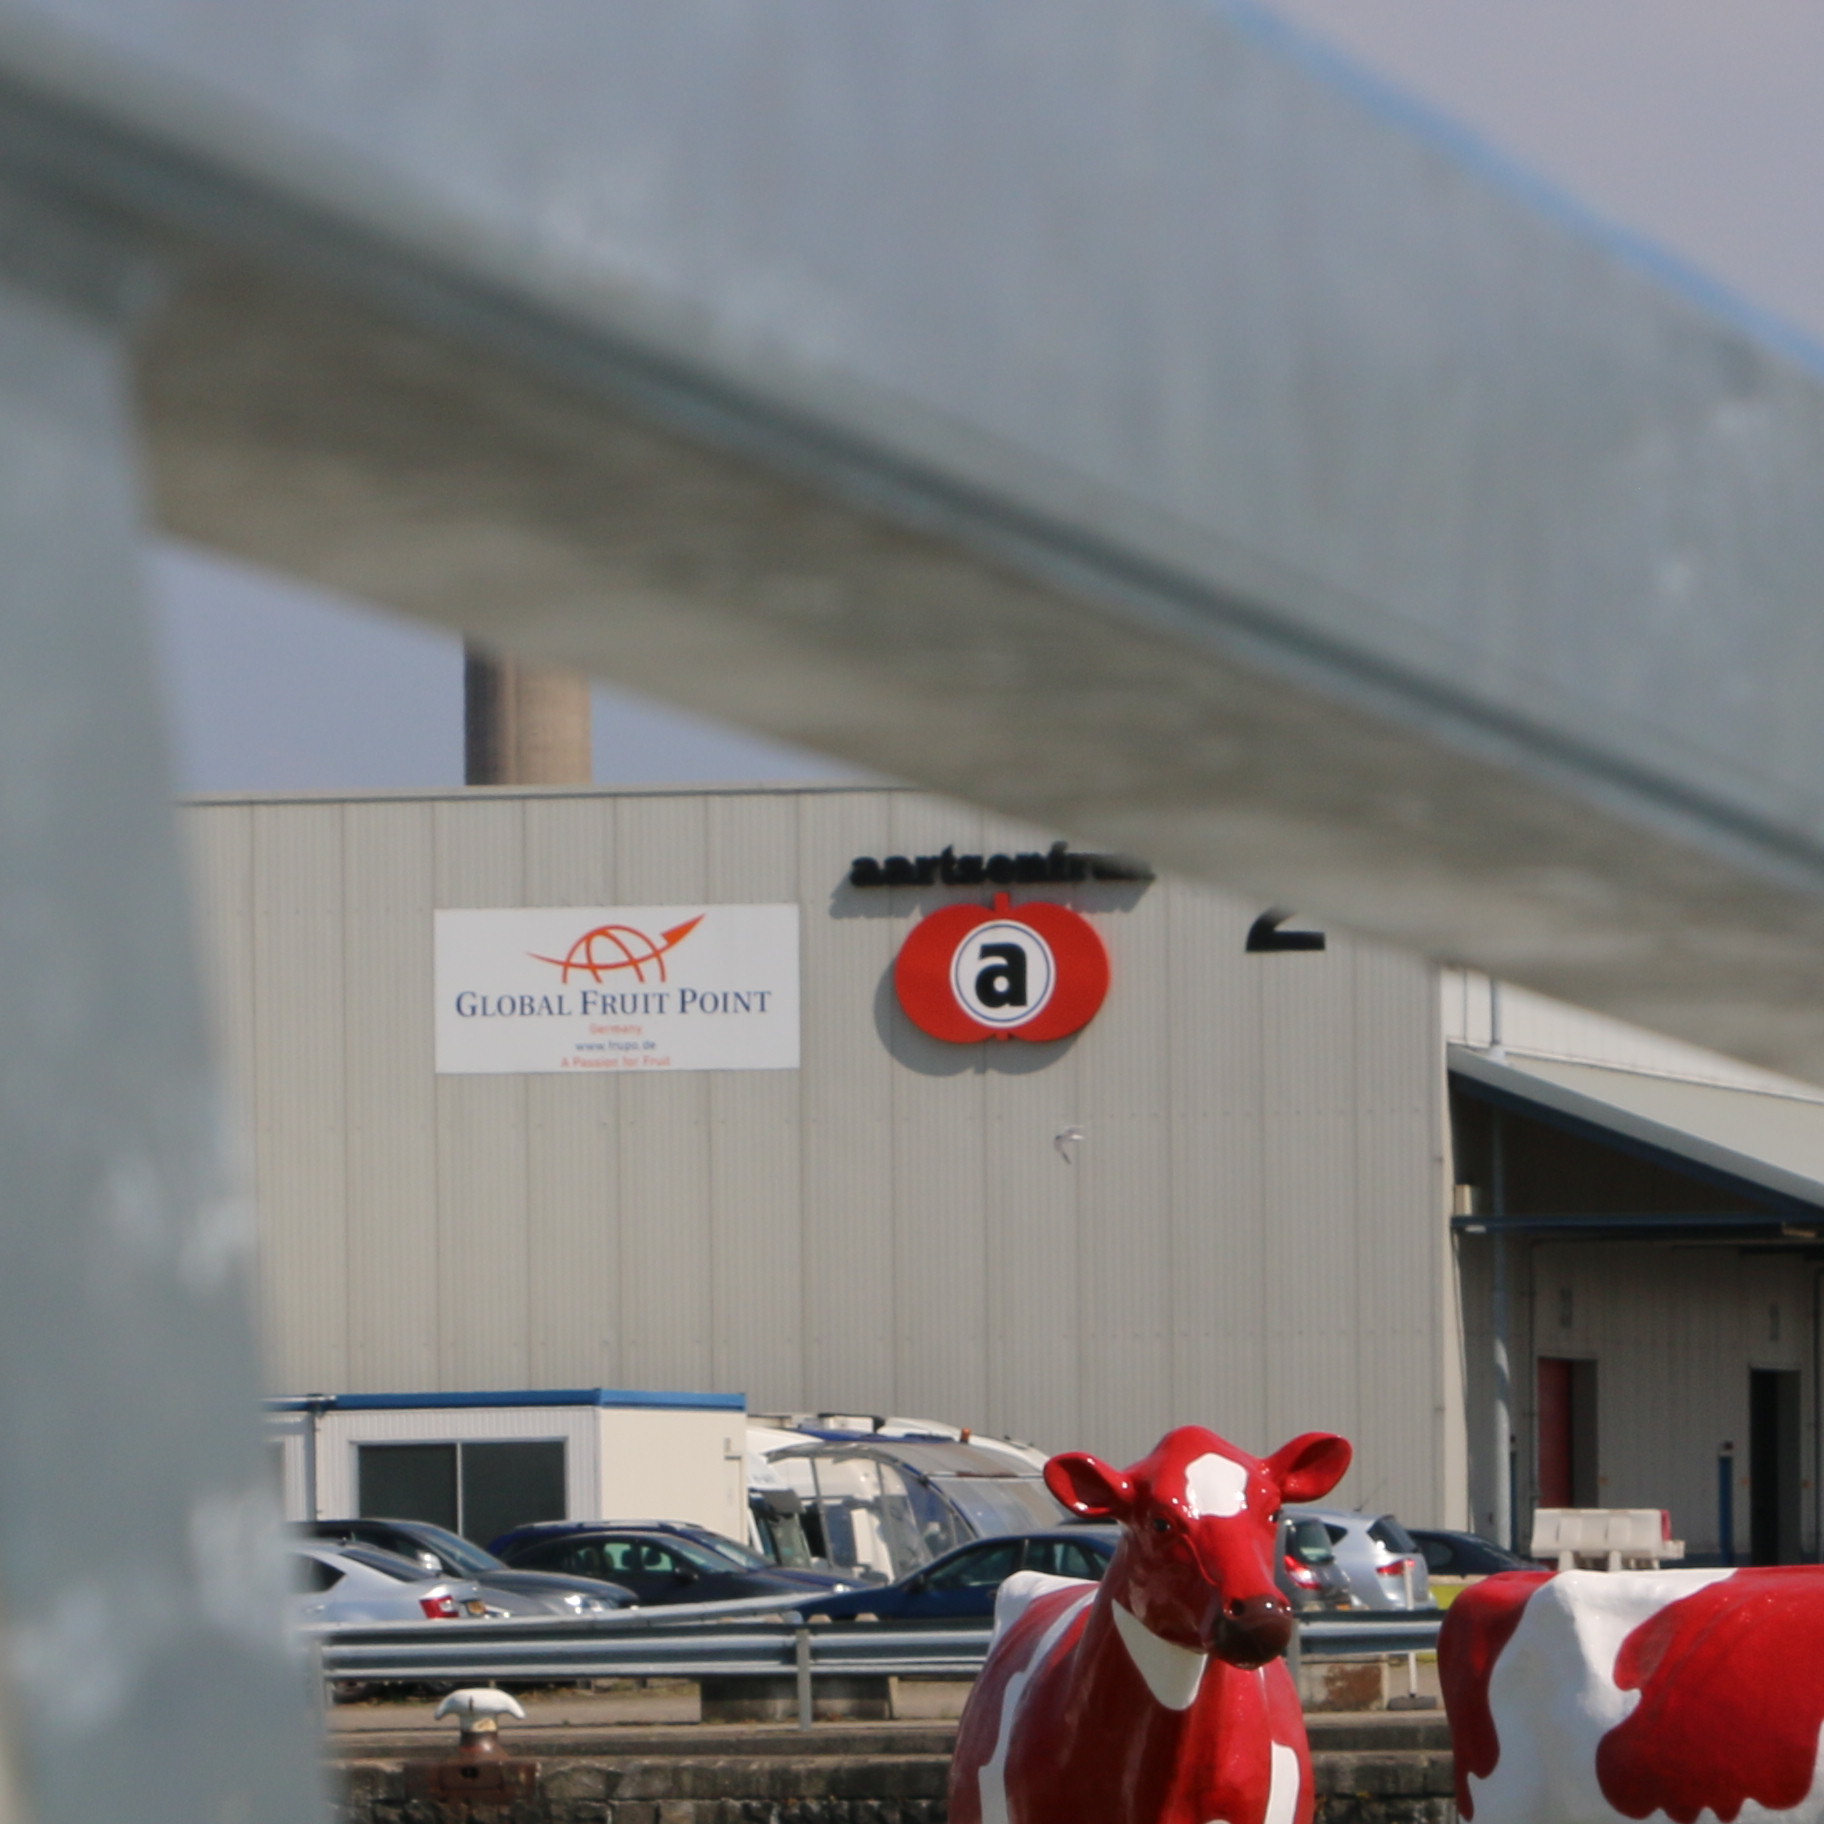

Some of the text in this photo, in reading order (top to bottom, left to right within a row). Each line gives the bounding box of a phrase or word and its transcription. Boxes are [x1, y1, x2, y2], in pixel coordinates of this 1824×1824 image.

[975, 942, 1027, 1009] a
[455, 988, 772, 1017] GLOBAL FRUIT POINT
[589, 1023, 643, 1035] Germany
